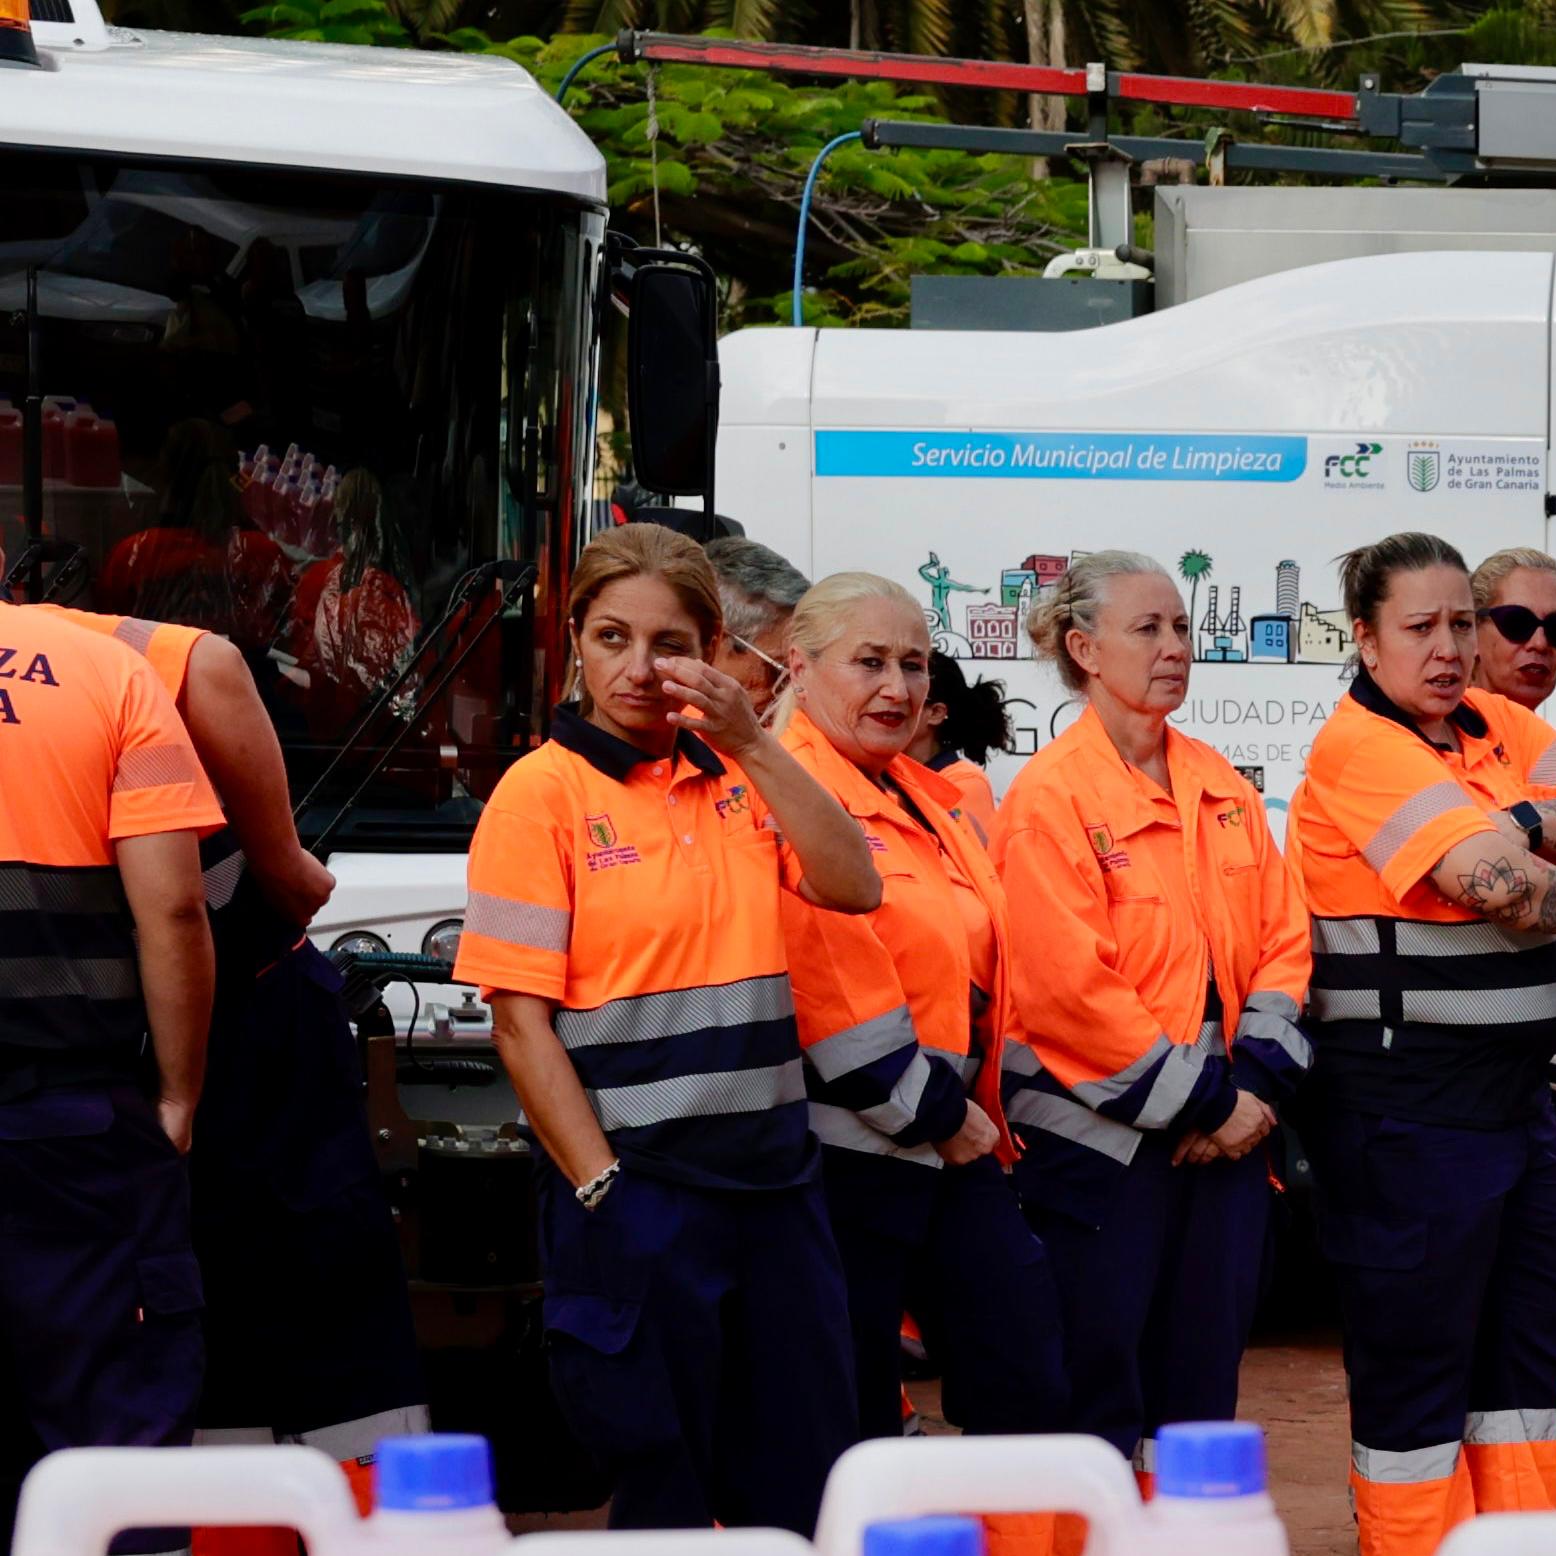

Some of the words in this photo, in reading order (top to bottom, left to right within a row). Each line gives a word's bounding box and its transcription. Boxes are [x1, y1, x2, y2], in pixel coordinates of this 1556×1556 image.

[911, 442, 1004, 468] Servicio
[1010, 443, 1132, 473] Municipal
[1138, 445, 1166, 470] de
[1172, 446, 1283, 475] Limpieza
[1447, 454, 1540, 465] Ayuntamiento
[1325, 455, 1371, 477] FCC
[1447, 466, 1462, 476] de
[1469, 467, 1489, 477] Las
[1496, 467, 1540, 477] Palmas
[1447, 479, 1462, 488] de
[1465, 479, 1492, 489] Gran
[1495, 480, 1540, 490] Canaria
[1266, 744, 1293, 762] DE
